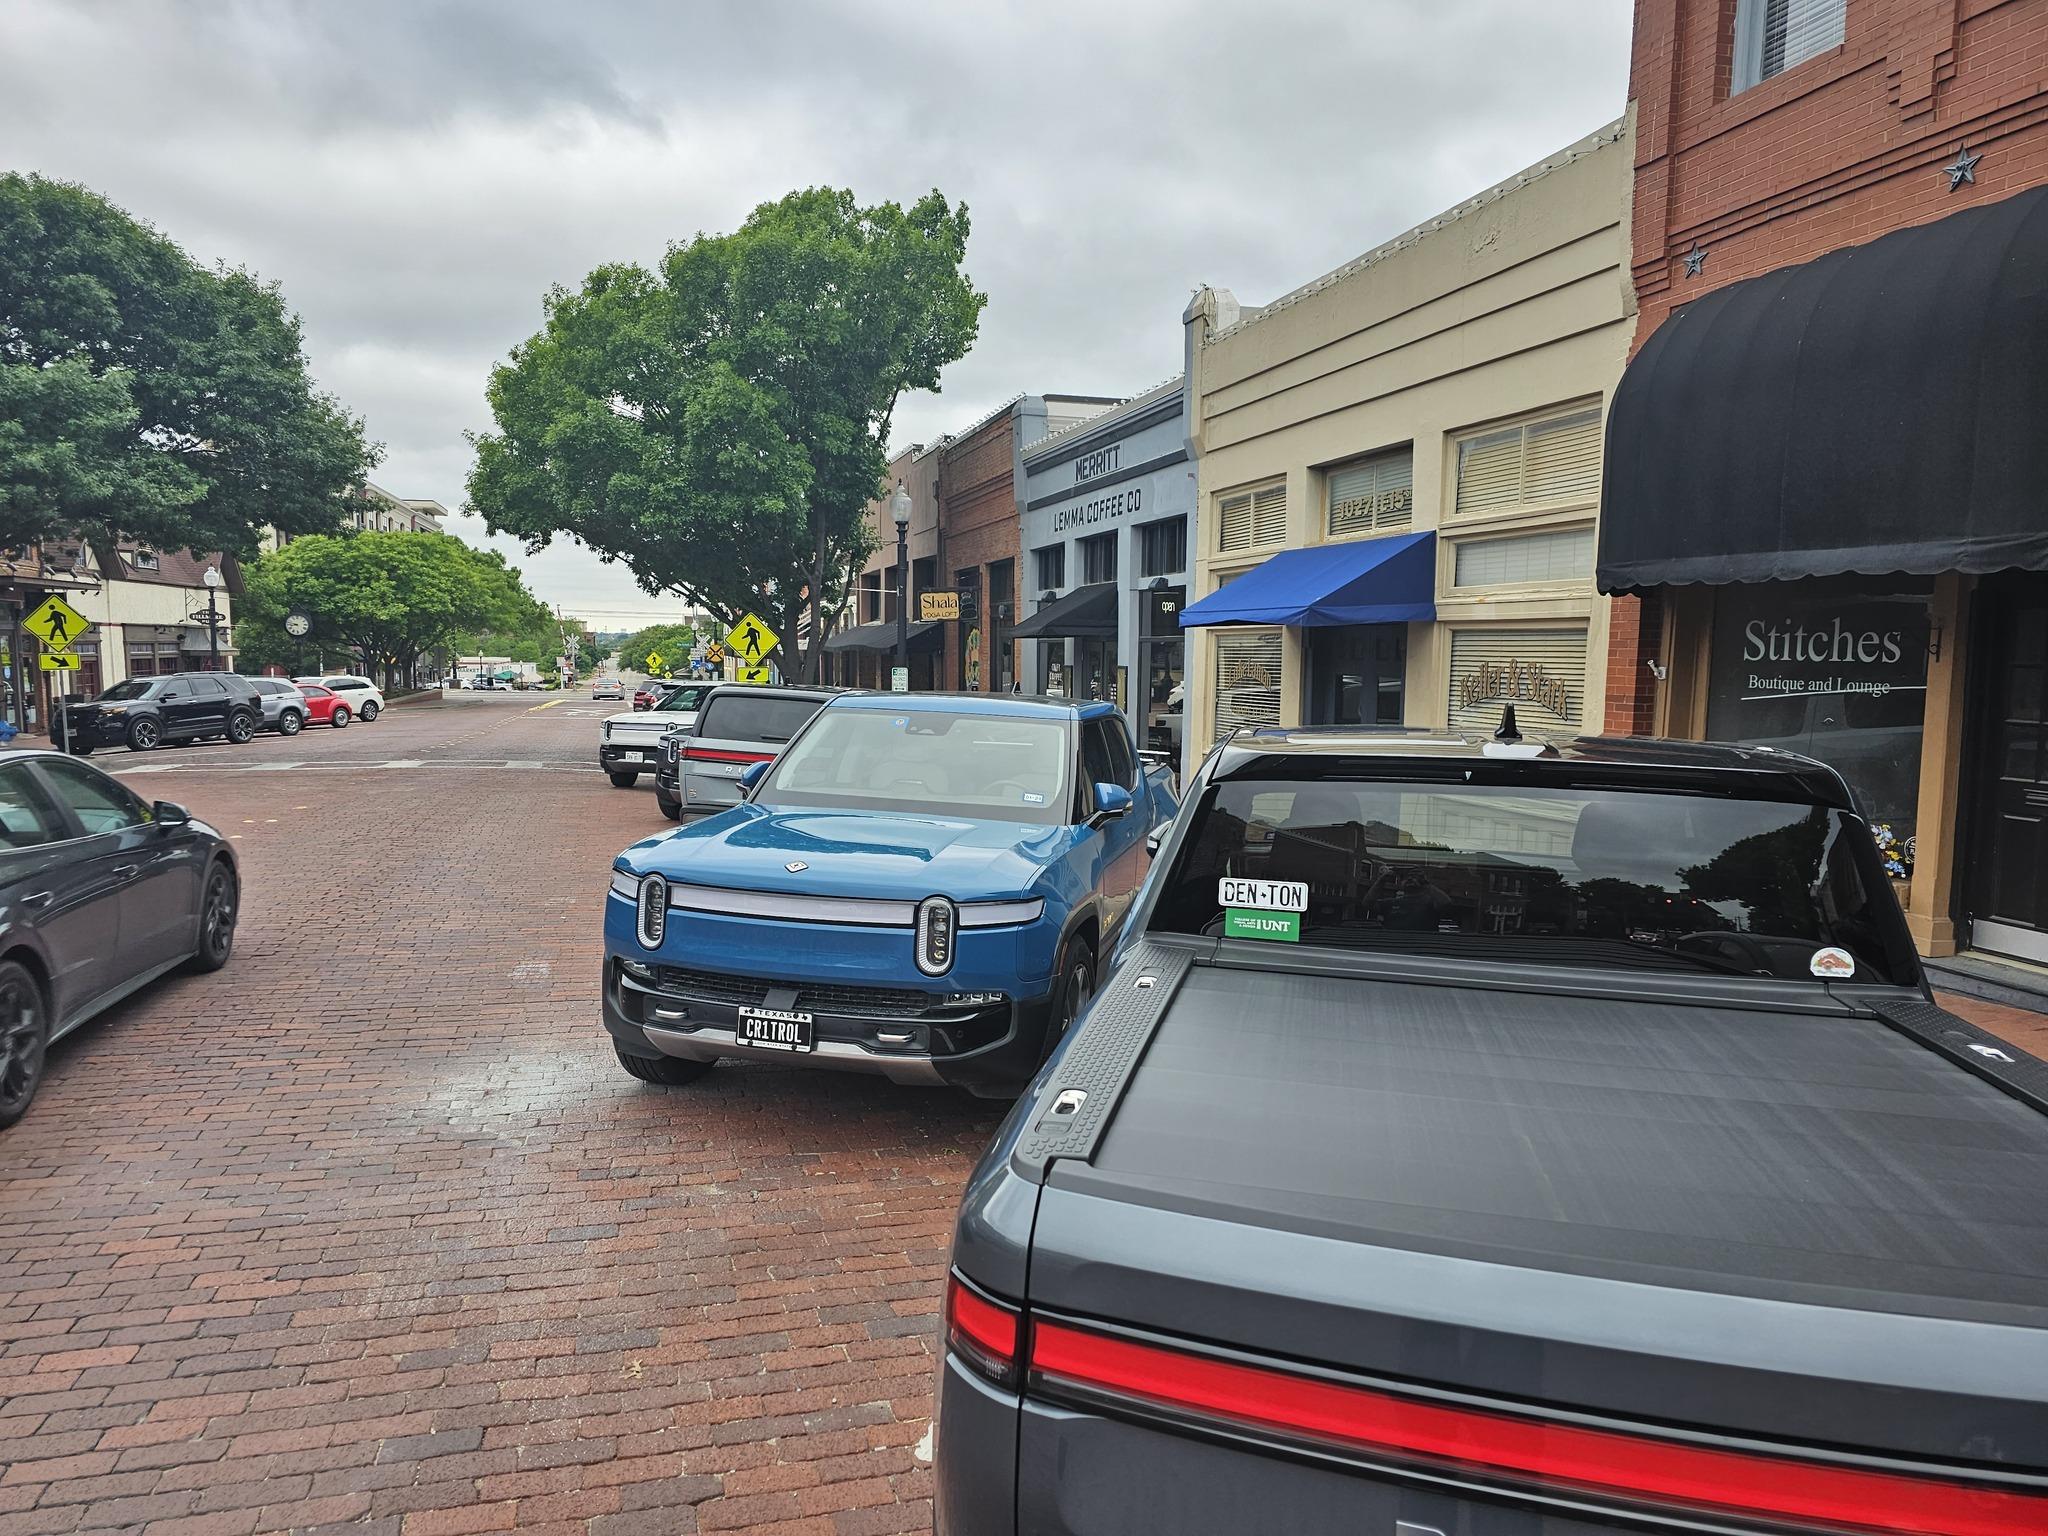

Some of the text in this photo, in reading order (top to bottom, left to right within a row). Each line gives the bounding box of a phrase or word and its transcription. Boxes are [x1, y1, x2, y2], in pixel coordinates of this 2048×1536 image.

[1076, 444, 1120, 482] MERRITT
[1055, 489, 1141, 532] LEMMA COFFEE CO
[922, 595, 958, 609] Shala
[1162, 602, 1175, 614] open
[1743, 617, 1901, 664] Stitches
[1460, 659, 1569, 722] Keller & Stark
[1748, 674, 1890, 698] Boutique and Lounge
[1224, 882, 1301, 907] DEN TON
[1262, 919, 1290, 931] UNT
[758, 1009, 793, 1018] TEXAS
[746, 1019, 802, 1042] CR1TROL
